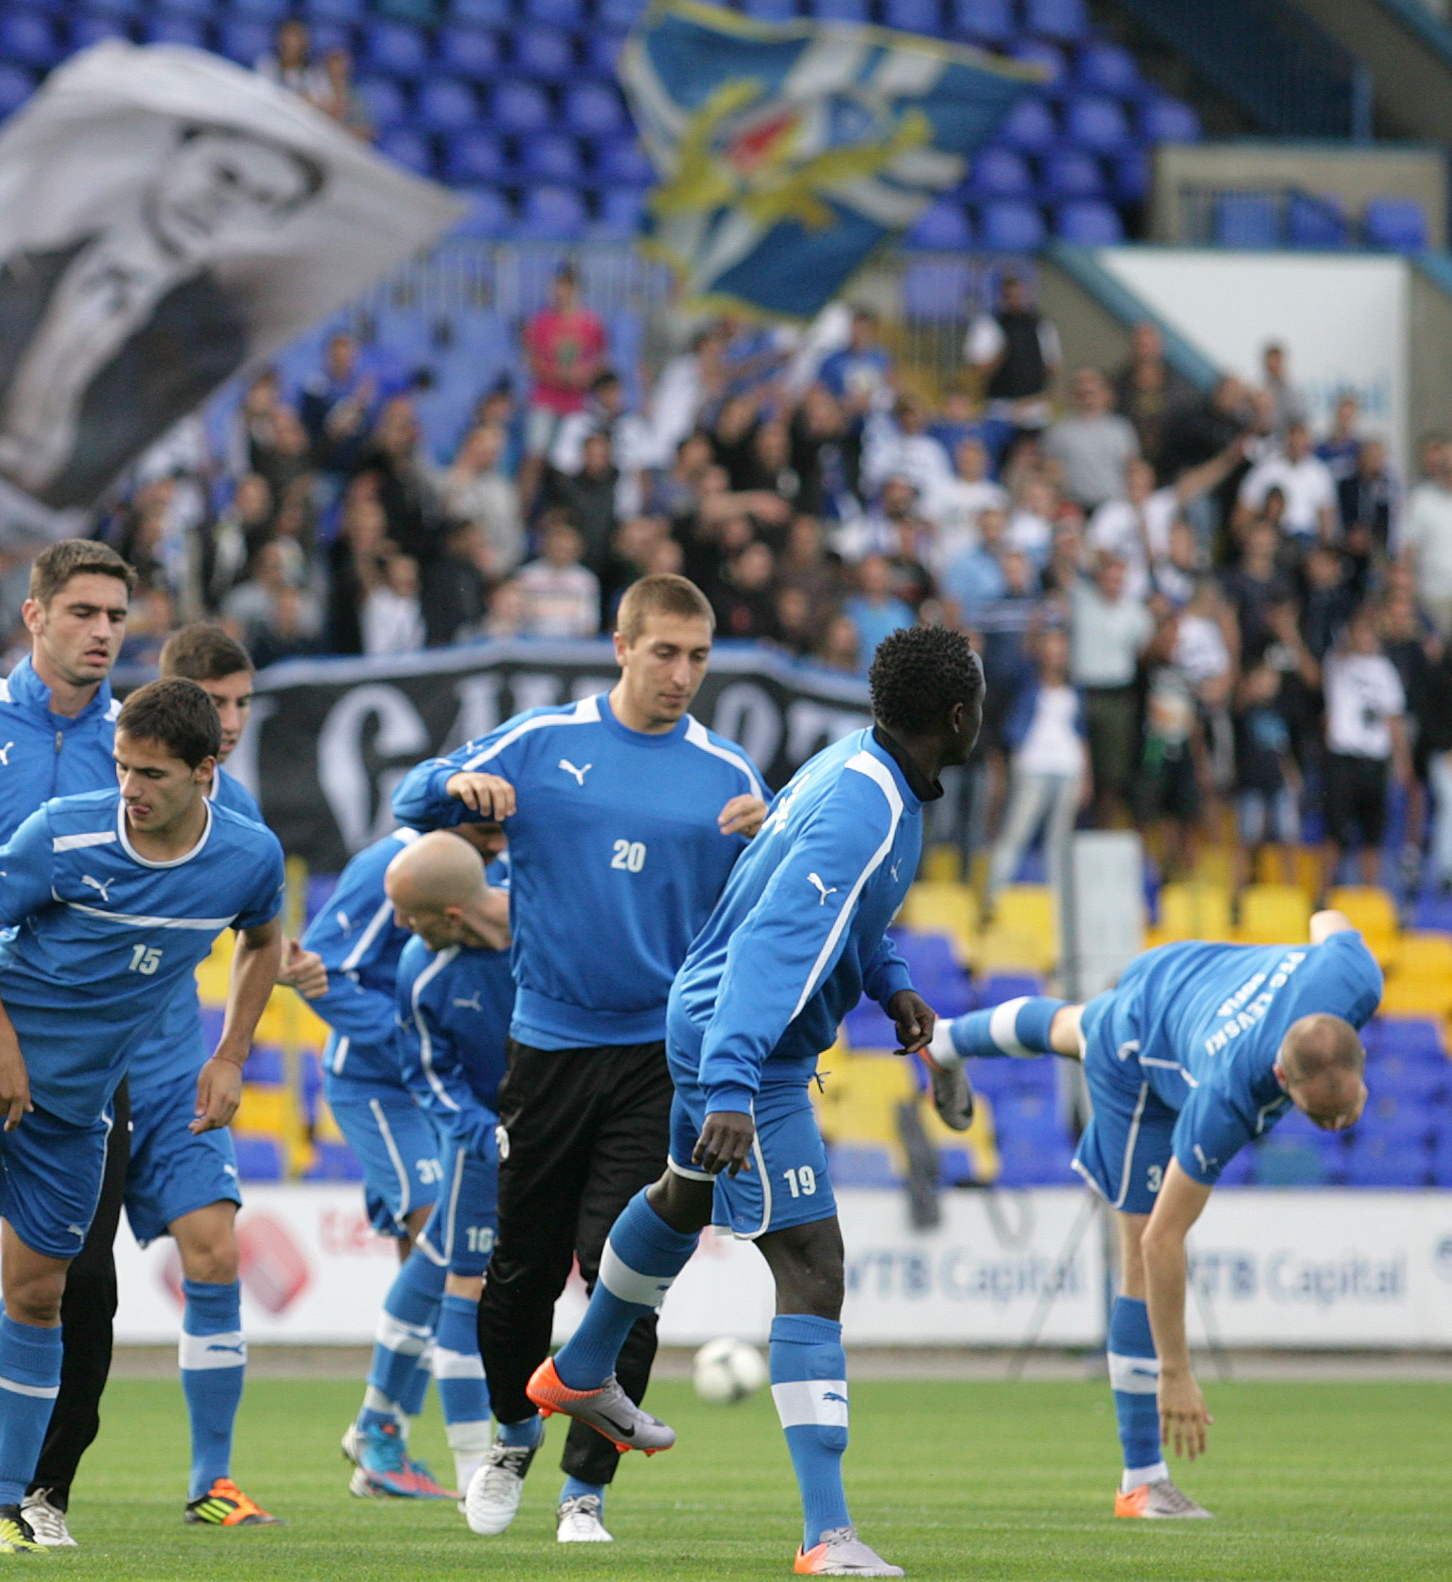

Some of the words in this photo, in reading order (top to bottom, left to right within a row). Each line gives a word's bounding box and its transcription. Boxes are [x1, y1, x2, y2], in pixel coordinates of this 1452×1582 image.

[610, 839, 647, 873] 20
[127, 943, 164, 975] 15
[1204, 991, 1274, 1057] LEVSKI
[782, 1164, 817, 1199] 19
[465, 1226, 495, 1253] 16
[941, 1246, 1085, 1305] Capital
[1265, 1247, 1406, 1310] Capital
